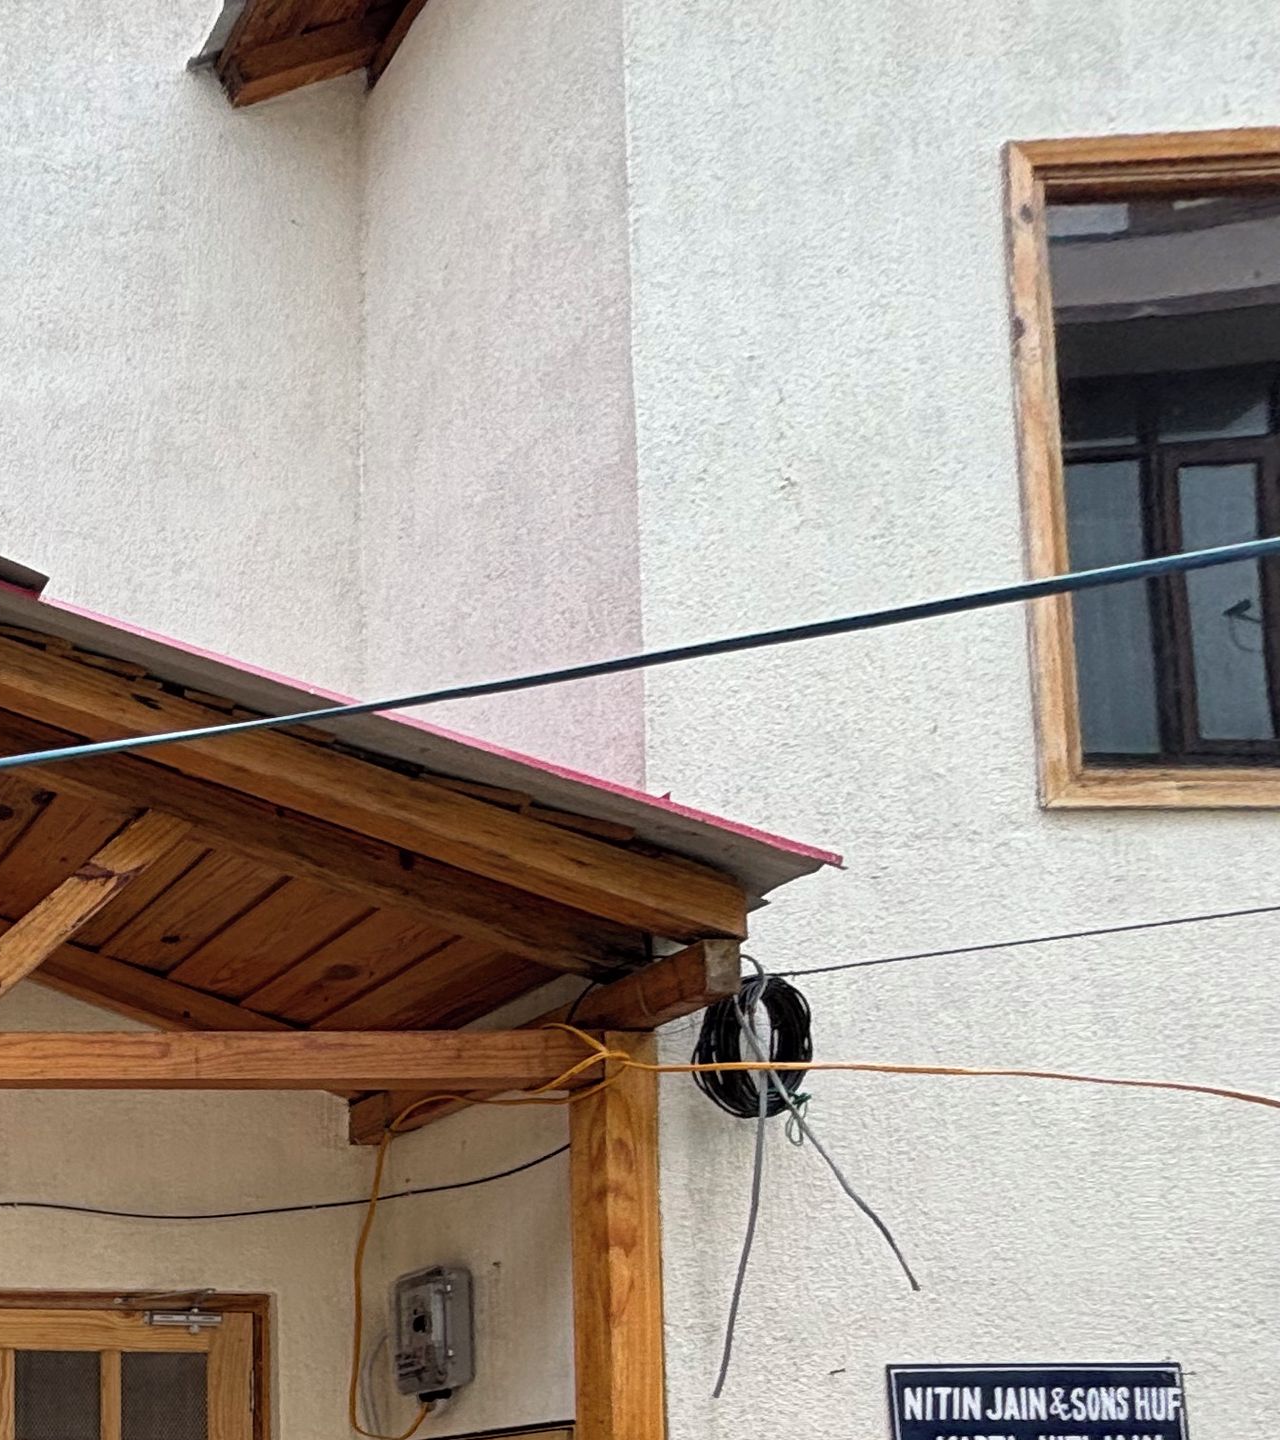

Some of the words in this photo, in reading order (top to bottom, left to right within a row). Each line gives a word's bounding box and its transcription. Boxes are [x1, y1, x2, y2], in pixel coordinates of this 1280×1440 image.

[903, 1386, 982, 1422] NITIN
[985, 1386, 1048, 1422] JAIN
[1133, 1386, 1182, 1421] HUF
